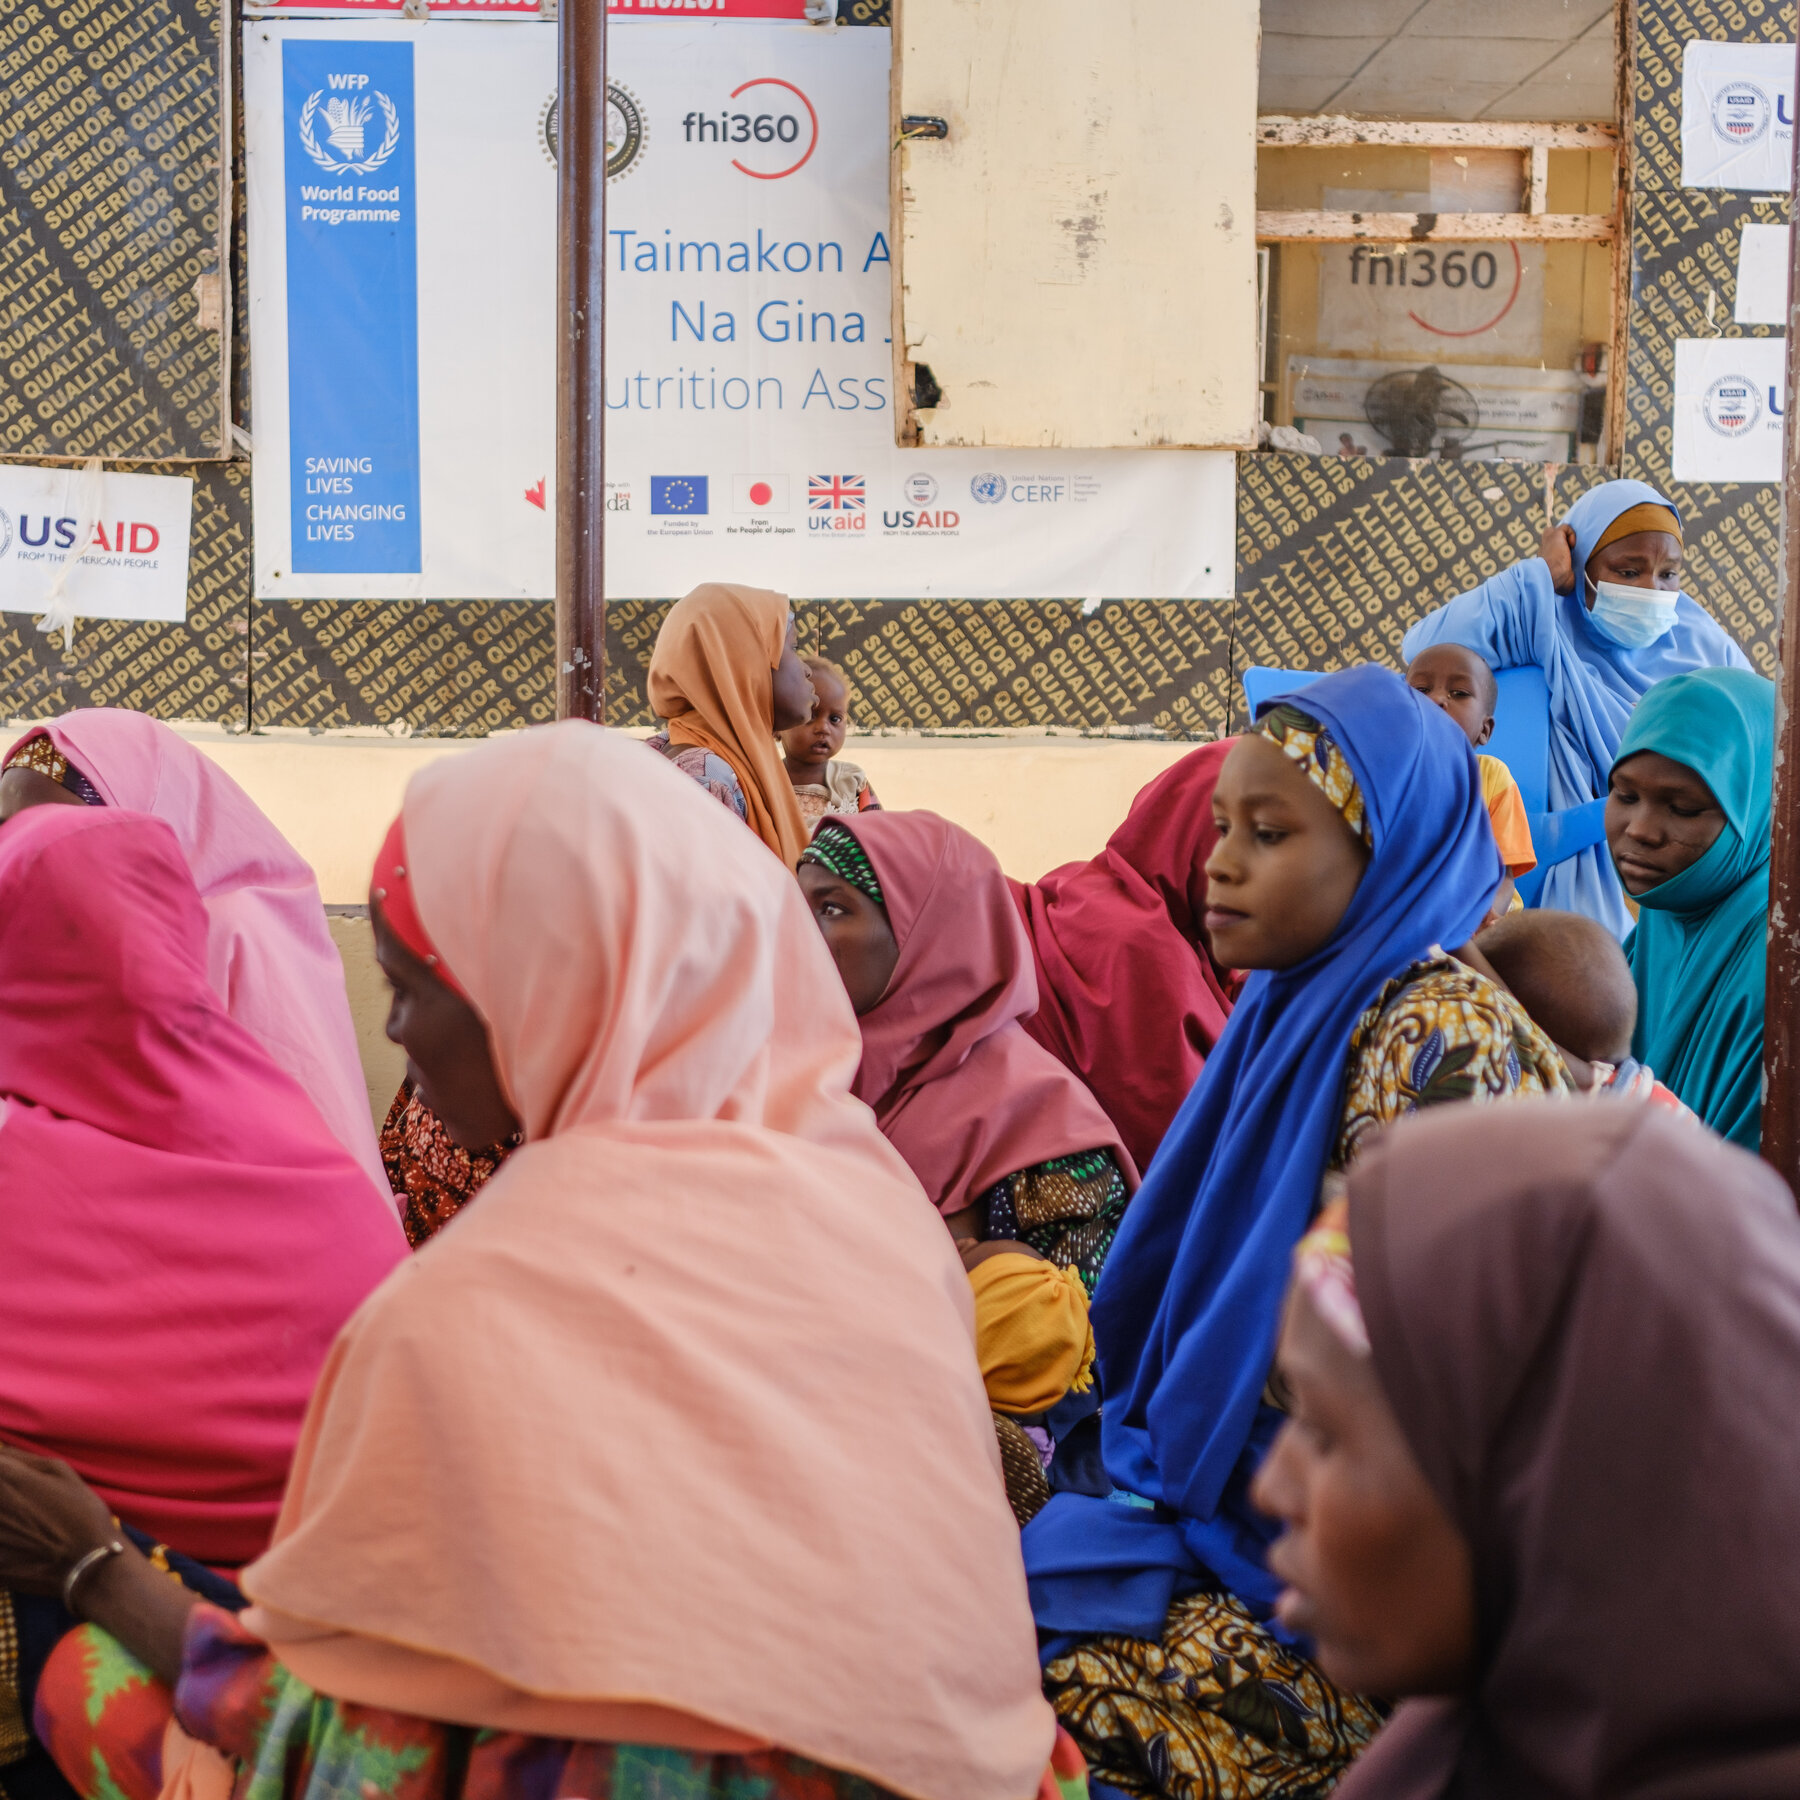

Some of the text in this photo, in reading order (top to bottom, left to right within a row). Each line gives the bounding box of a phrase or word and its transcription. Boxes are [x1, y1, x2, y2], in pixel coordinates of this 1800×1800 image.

[73, 0, 144, 50] QUALI
[0, 45, 74, 116] PERIOR
[0, 14, 186, 148] UPERIOR QUALITY
[2, 36, 200, 169] SUPERIOR QUALITY
[328, 74, 369, 90] WFP
[16, 105, 117, 189] SUPERIOR
[129, 56, 214, 131] QUALITY
[30, 126, 131, 209] SUPERIOR
[144, 84, 220, 151] QUALIT
[682, 112, 799, 143] fhi360
[44, 146, 146, 230] SUPERIOR
[159, 113, 220, 171] QUALI
[58, 166, 160, 250] SUPERIOR
[301, 186, 399, 201] World Food
[72, 186, 174, 270] SUPERIOR
[87, 207, 188, 289] SUPERIOR
[301, 205, 400, 225] Programme
[609, 228, 843, 272] Taimakon
[101, 227, 202, 309] SUPERIOR
[115, 247, 217, 329] SUPERIOR
[0, 287, 78, 360] QUALITY
[9, 307, 93, 380] QUALITY
[671, 299, 865, 343] Na Gina
[23, 327, 107, 400] QUALITY
[37, 347, 121, 419] QUALITY
[51, 367, 135, 439] QUALITY
[65, 387, 149, 456] QUALITY
[305, 457, 372, 474] SAVING
[306, 477, 353, 494] LIVES
[1011, 485, 1064, 502] CERF
[1637, 439, 1703, 522] QUALITY
[20, 514, 160, 554] USAID
[188, 522, 244, 580] ALITY
[306, 504, 406, 521] CHANGING
[307, 524, 355, 541] LIVES
[883, 511, 960, 528] USAID
[1353, 504, 1419, 587] QUALITY
[1372, 490, 1438, 573] QUALITY
[1391, 475, 1457, 559] QUALITY
[76, 555, 121, 566] MERICAN
[124, 558, 159, 569] PEOPLE
[187, 547, 250, 611] UALIT
[1298, 546, 1364, 629] QUALITY
[1317, 532, 1383, 615] QUALITY
[1335, 518, 1401, 601] QUALITY
[1683, 544, 1756, 642] SUPERIOR
[1701, 530, 1775, 629] SUPERIOR
[190, 576, 249, 632] QUALI
[330, 600, 425, 667] SUPERIO
[1242, 588, 1309, 670] QUALITY
[1261, 574, 1328, 656] QUALITY
[1279, 560, 1346, 643] QUALITY
[61, 619, 134, 668] SUPER
[75, 621, 169, 688] SUPERIO
[90, 627, 191, 707] SUPERIOR
[117, 646, 206, 712] UPERIOR
[251, 646, 307, 704] ALITY
[345, 604, 445, 686] SUPERIOR
[360, 623, 459, 704] SUPERIOR
[374, 641, 474, 723] SUPERIOR
[487, 601, 556, 664] QUALIT
[864, 635, 943, 728] SUPERIOR
[882, 620, 961, 719] SUPERIOR
[901, 606, 979, 705] SUPERIOR
[1067, 633, 1138, 716] QUALITY
[1086, 619, 1156, 702] QUALITY
[1104, 604, 1175, 687] QUALITY
